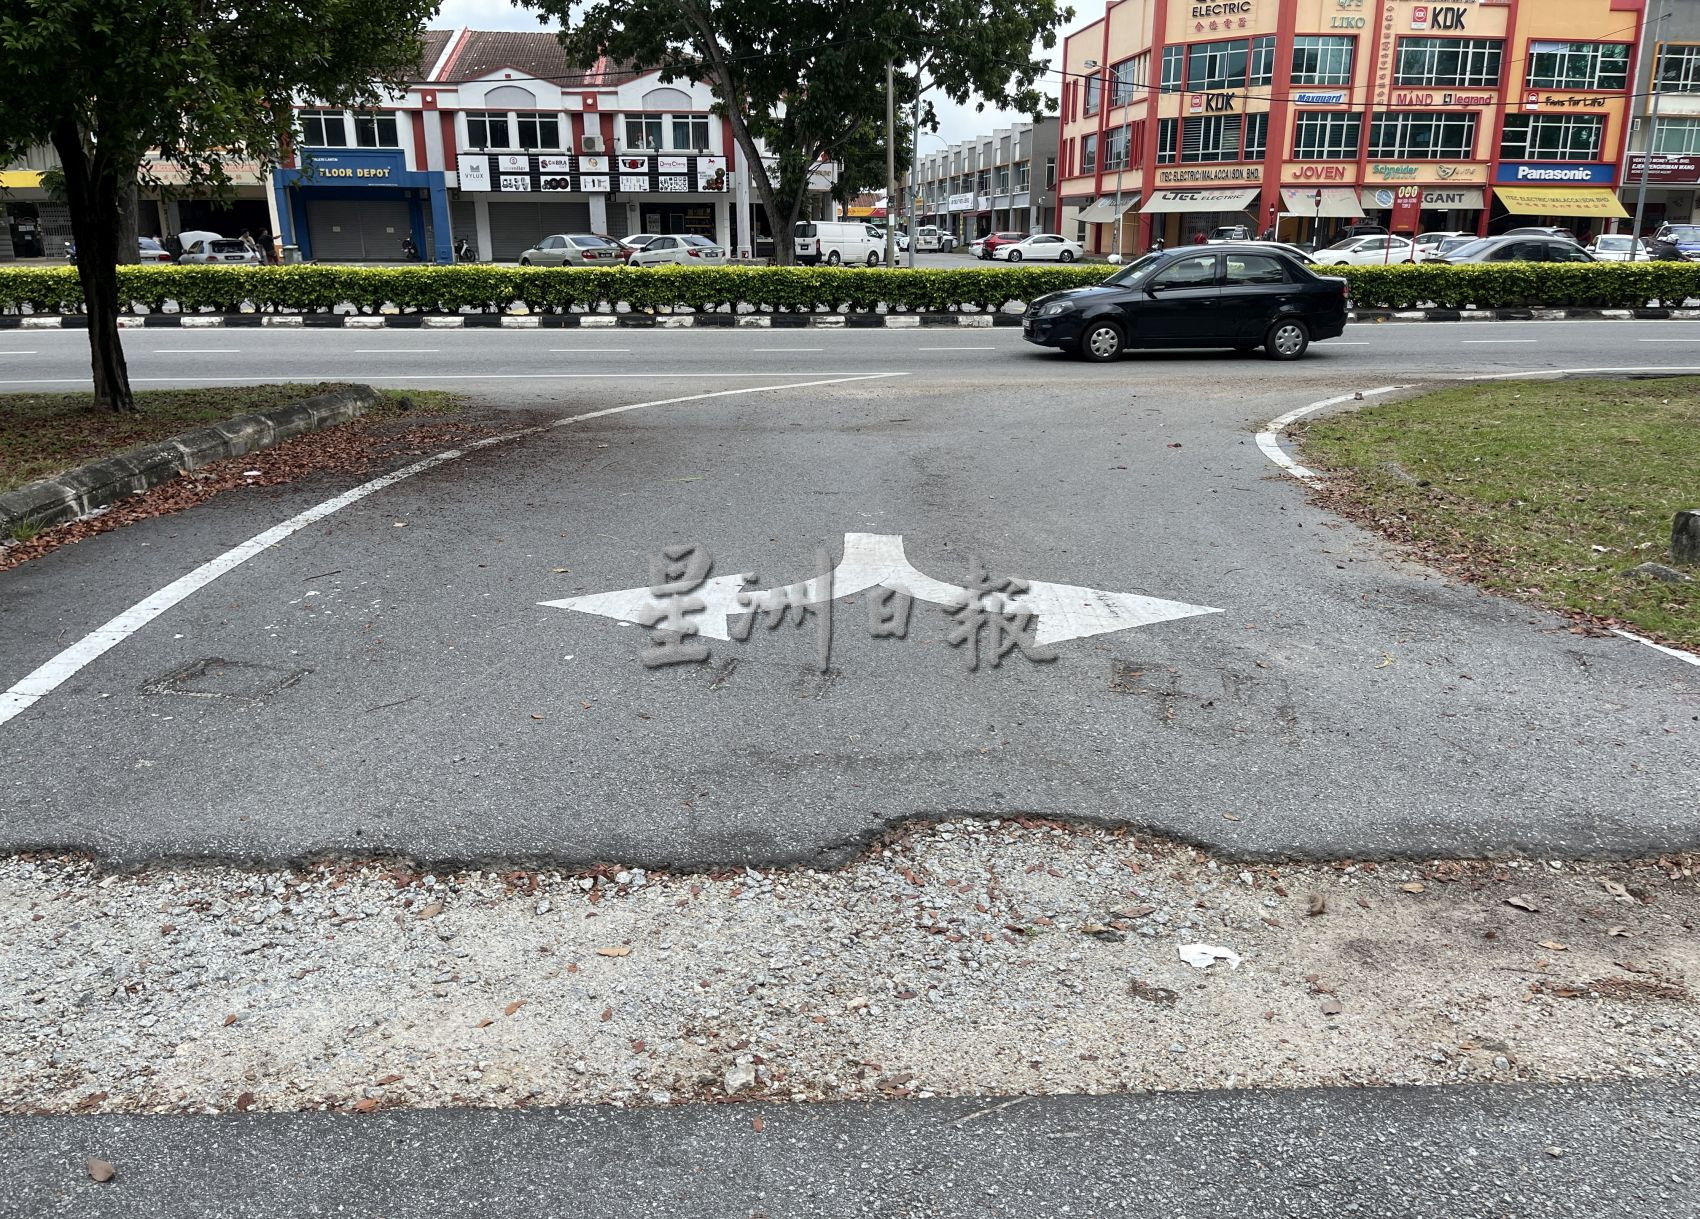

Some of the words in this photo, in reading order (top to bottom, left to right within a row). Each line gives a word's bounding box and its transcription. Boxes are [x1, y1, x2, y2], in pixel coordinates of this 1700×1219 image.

[1192, 1, 1251, 17] ELECTRIC
[1330, 16, 1365, 29] LIKO
[1431, 6, 1467, 29] KDK
[1206, 92, 1235, 112] KDK
[320, 168, 353, 177] FLOOR
[357, 168, 389, 178] DEPOT
[1293, 166, 1345, 179] JOVEN
[1517, 166, 1592, 180] Panasonic
